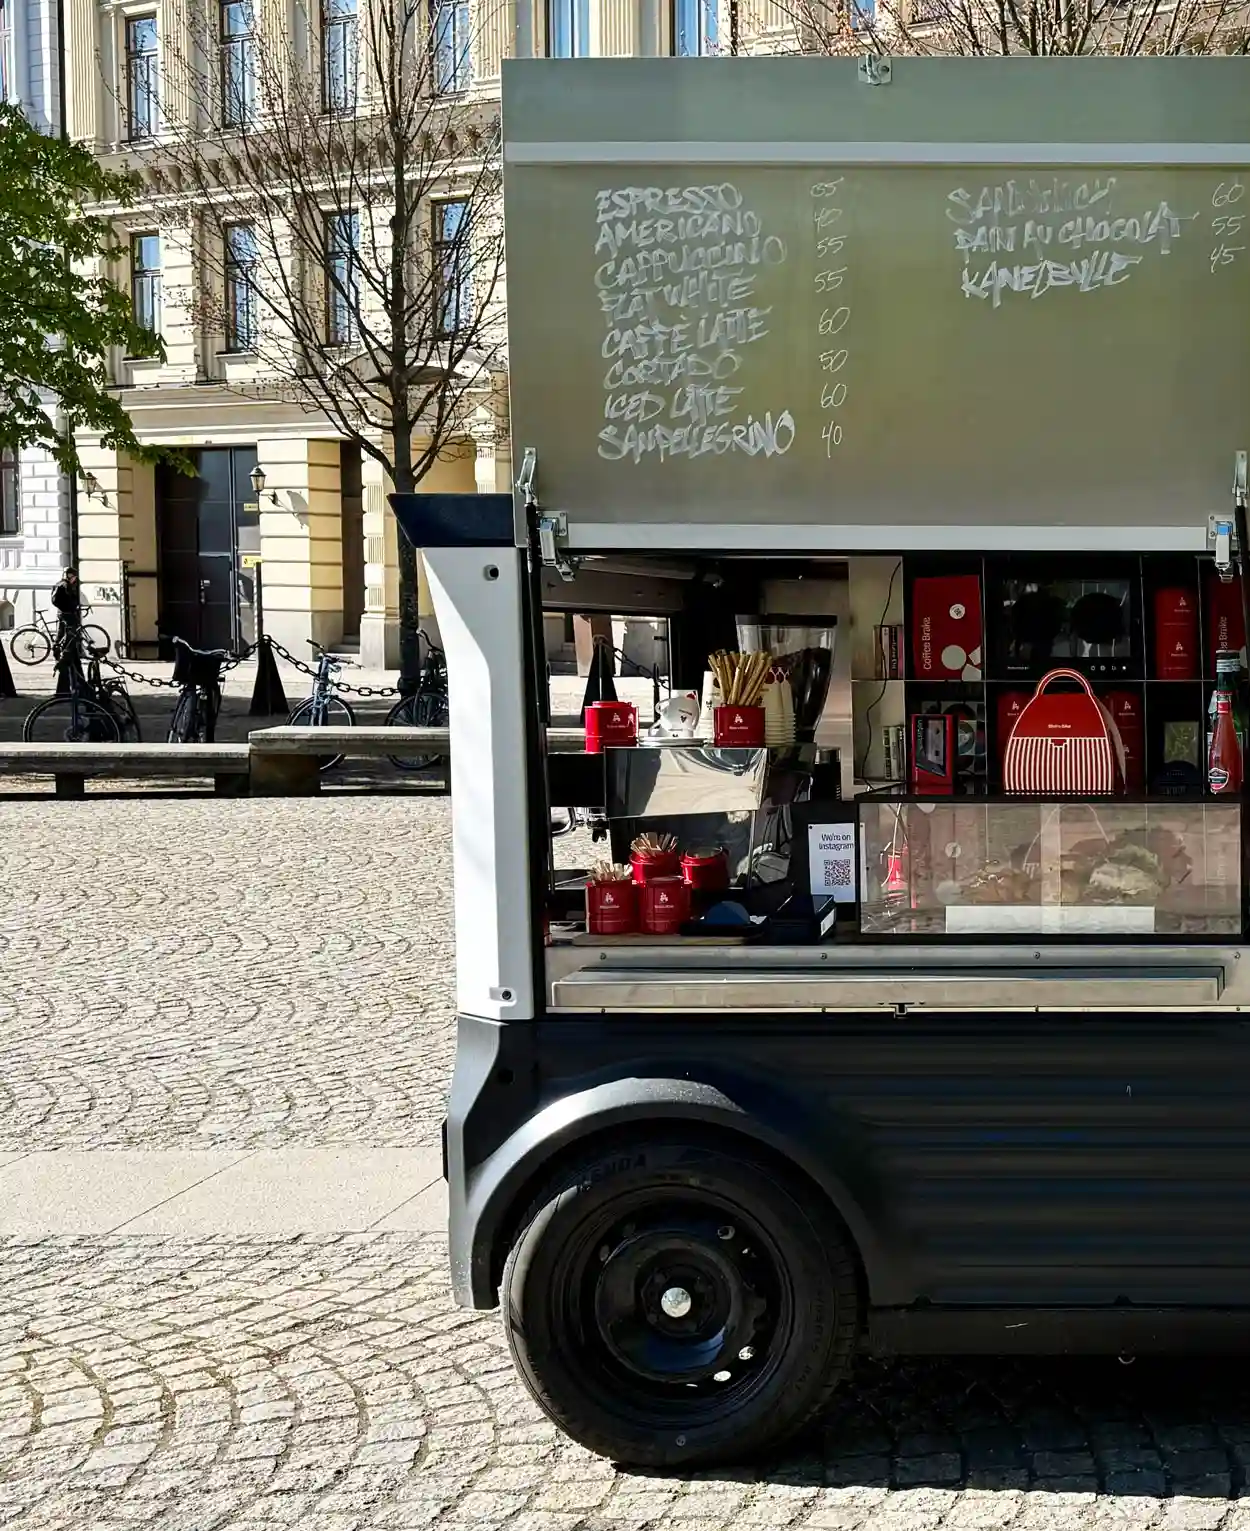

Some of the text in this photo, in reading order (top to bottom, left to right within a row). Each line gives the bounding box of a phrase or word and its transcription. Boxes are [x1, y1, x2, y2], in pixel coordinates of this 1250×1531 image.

[595, 183, 742, 223] ESPRESSO
[1212, 183, 1245, 207] 60
[595, 207, 843, 258] AMERICANO 40
[1023, 219, 1053, 260] AU
[1058, 201, 1200, 255] CHOCOLAT
[1211, 215, 1246, 236] 55
[594, 235, 848, 290] CAPPUCCINO 55
[1210, 243, 1246, 274] 45
[662, 268, 757, 308] WHITE
[814, 267, 847, 293] 55
[697, 306, 773, 348] LATTE
[818, 307, 850, 334] 60
[603, 349, 848, 390] CORTADO 50
[604, 382, 847, 427] ICED LATTE 60
[821, 421, 843, 458] 40
[920, 616, 932, 670] Coffee Brake
